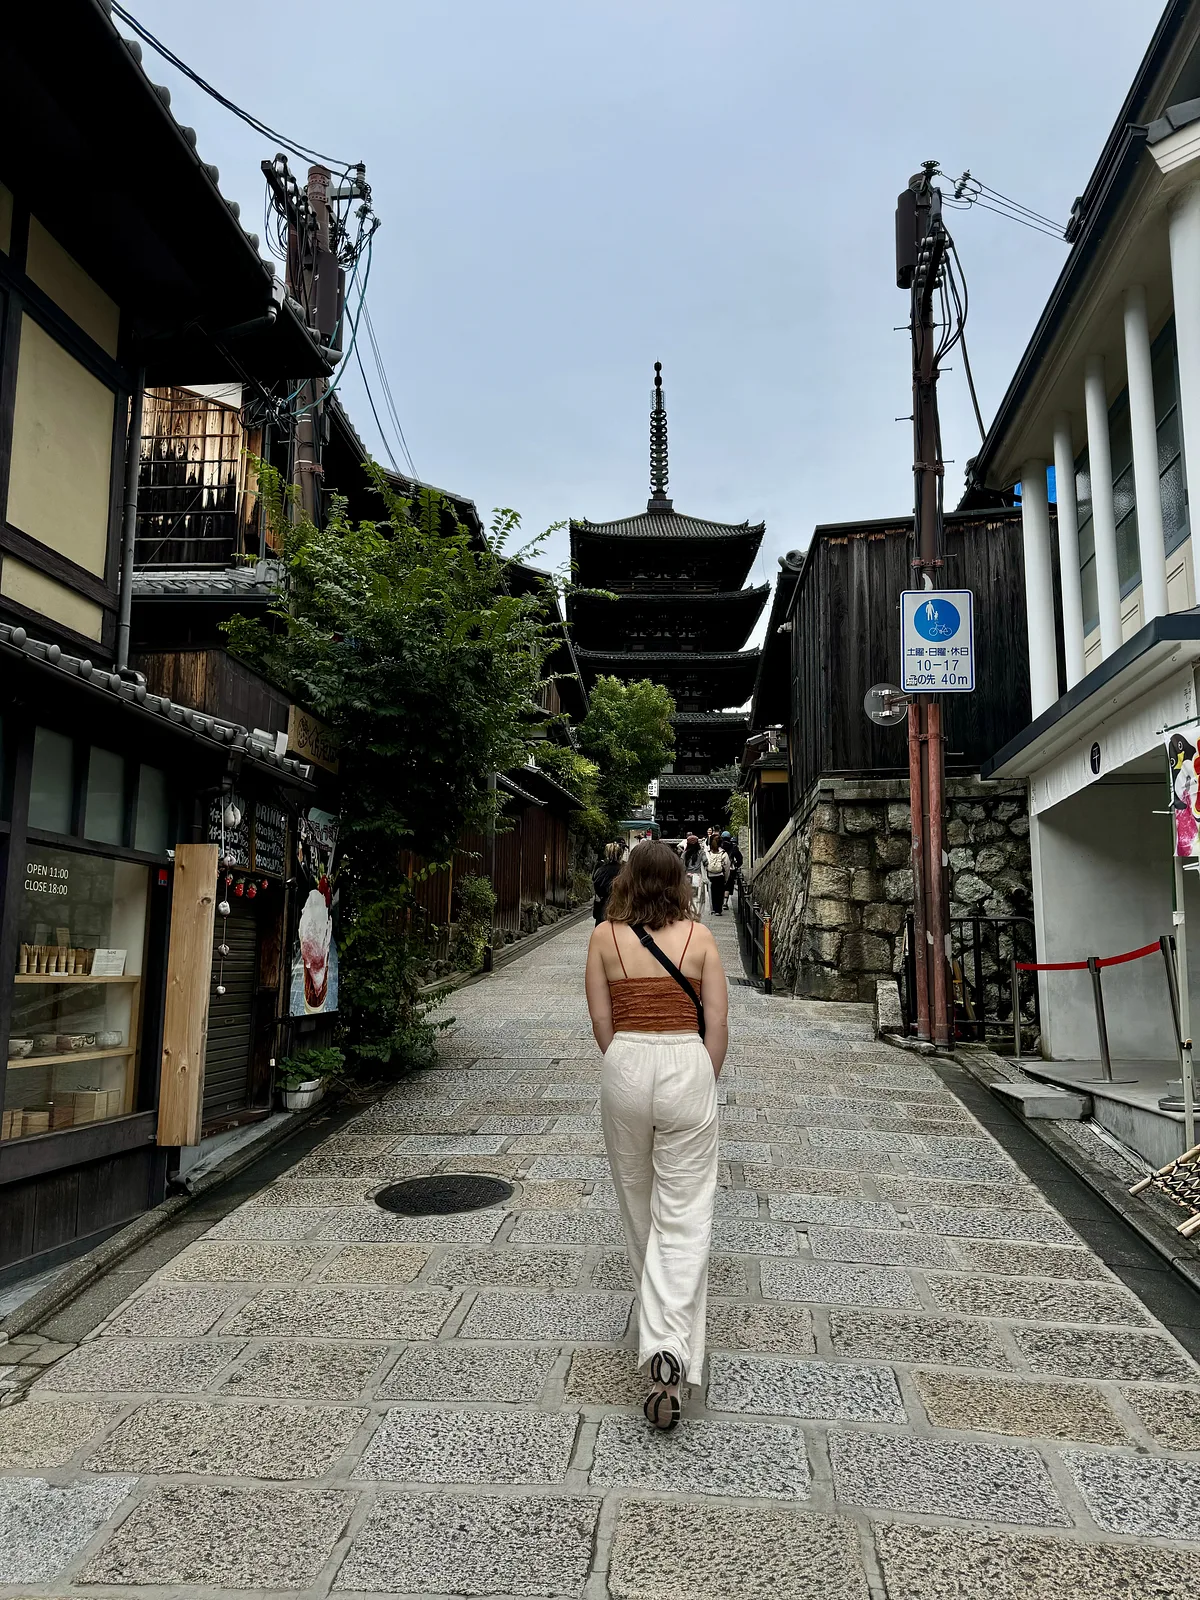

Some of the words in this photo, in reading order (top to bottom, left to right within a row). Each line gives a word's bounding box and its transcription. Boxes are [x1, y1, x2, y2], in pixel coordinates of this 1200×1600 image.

[26, 863, 48, 876] OPEN
[49, 867, 69, 879] 11:00
[24, 879, 47, 893] CLOSE
[48, 883, 68, 895] 18:00
